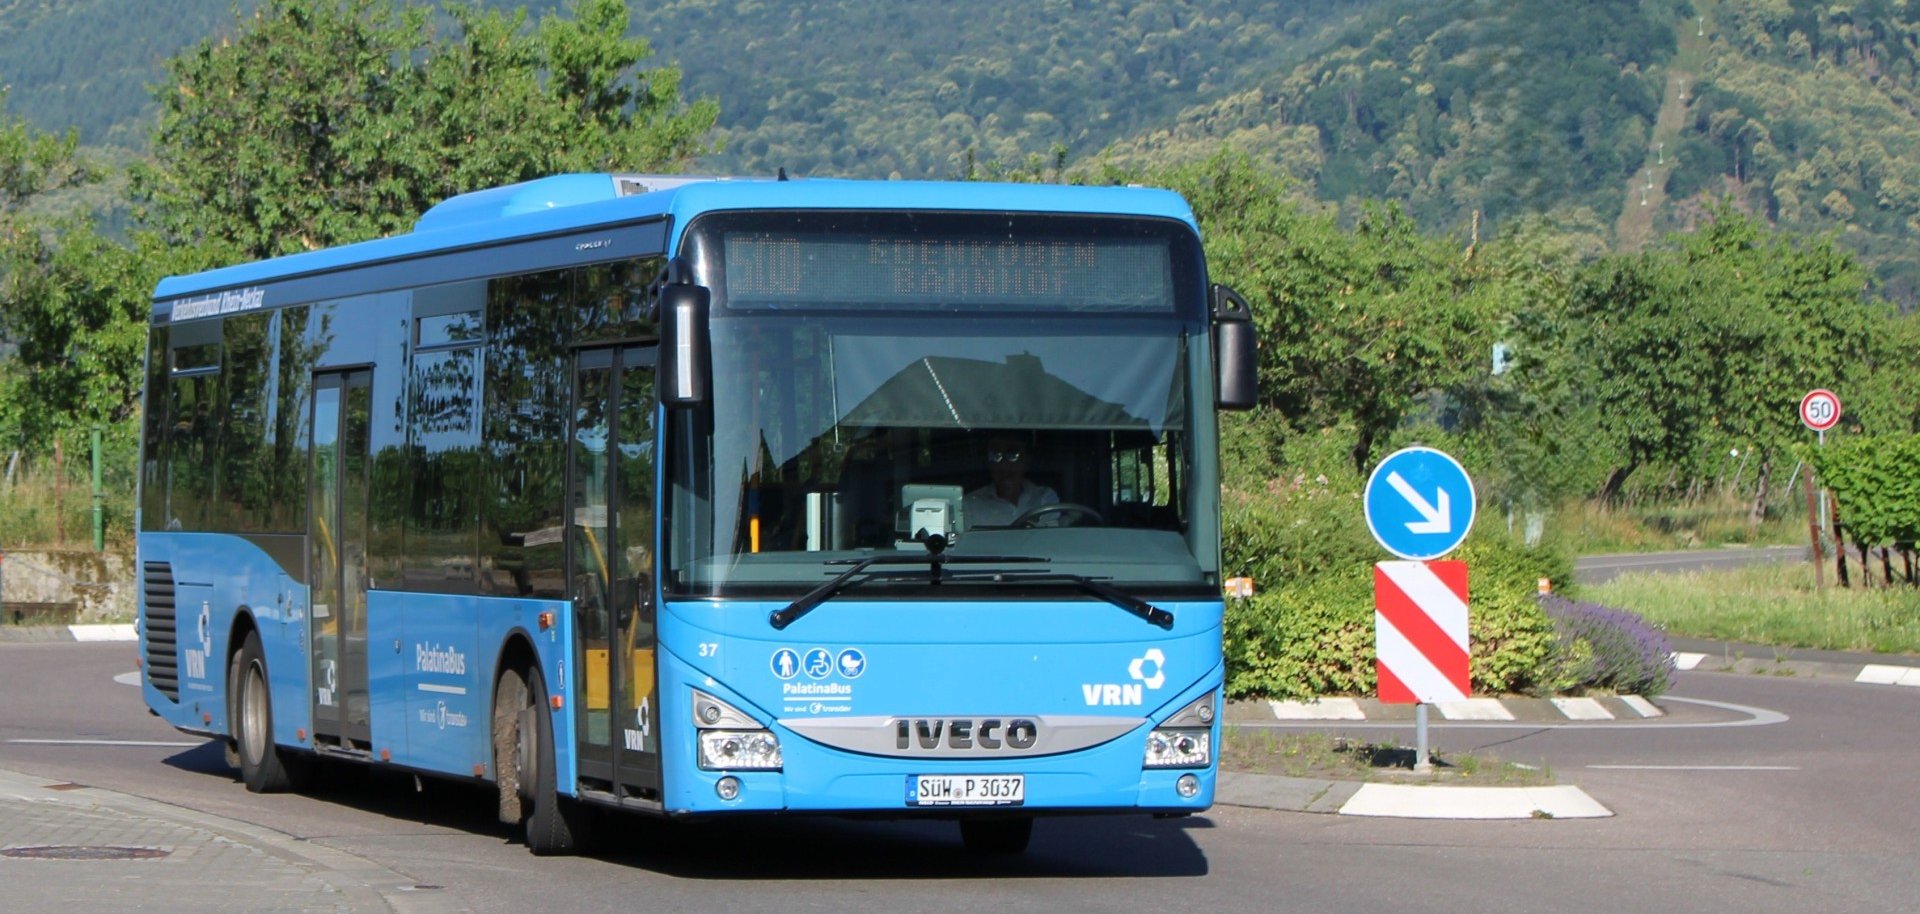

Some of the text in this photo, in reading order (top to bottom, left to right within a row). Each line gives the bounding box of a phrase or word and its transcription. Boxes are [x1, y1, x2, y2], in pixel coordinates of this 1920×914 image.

[870, 239, 1095, 267] EDENKOBEN
[732, 237, 800, 294] 500
[894, 268, 1071, 294] BAHNHOF
[1810, 401, 1831, 418] 50
[416, 641, 465, 675] PalatinaBus
[698, 643, 718, 657] 37
[185, 649, 205, 679] VRN
[318, 687, 333, 705] VRN
[783, 682, 852, 694] PalatinaBus
[1082, 684, 1142, 706] VRN
[624, 729, 644, 751] VRN
[896, 719, 1038, 750] IVECO
[920, 779, 1021, 797] SÜW P 3037
